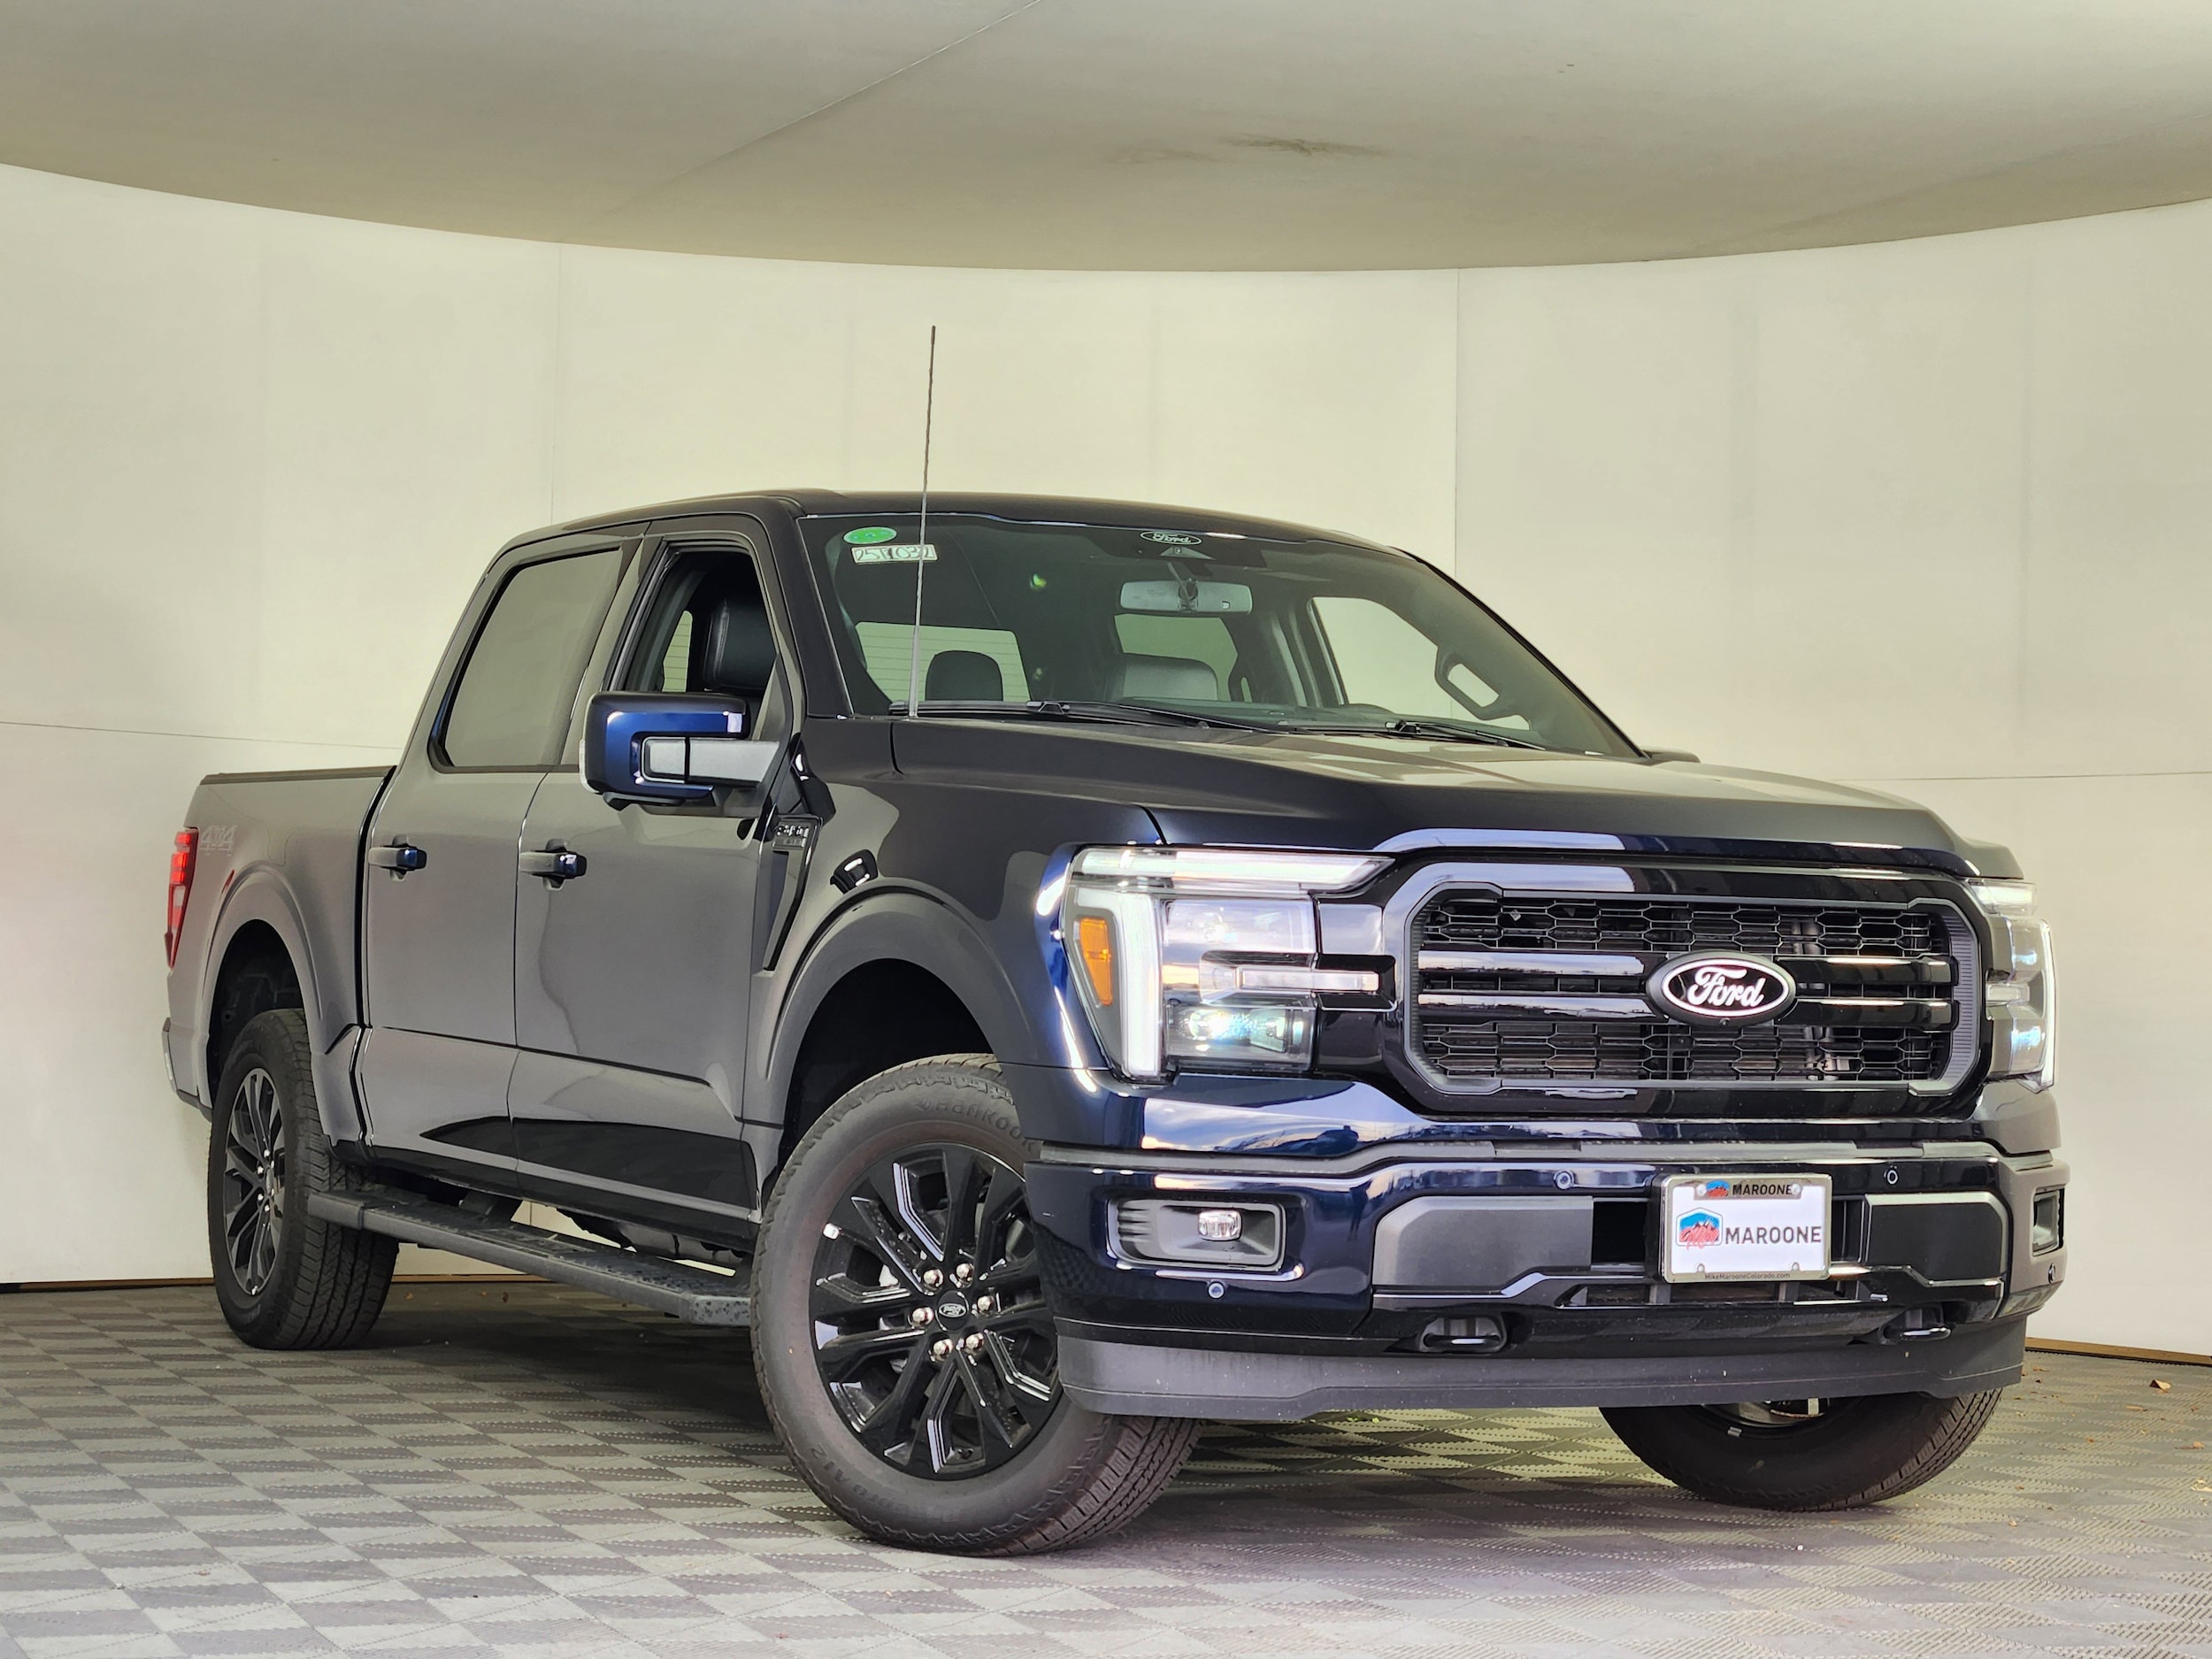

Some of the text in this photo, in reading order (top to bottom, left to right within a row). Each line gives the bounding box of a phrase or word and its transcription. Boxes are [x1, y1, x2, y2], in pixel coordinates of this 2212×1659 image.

[1153, 533, 1191, 543] Ford
[1686, 966, 1766, 1007] Ford
[1732, 1184, 1793, 1195] MAROONE
[1724, 1226, 1822, 1245] MAROONE
